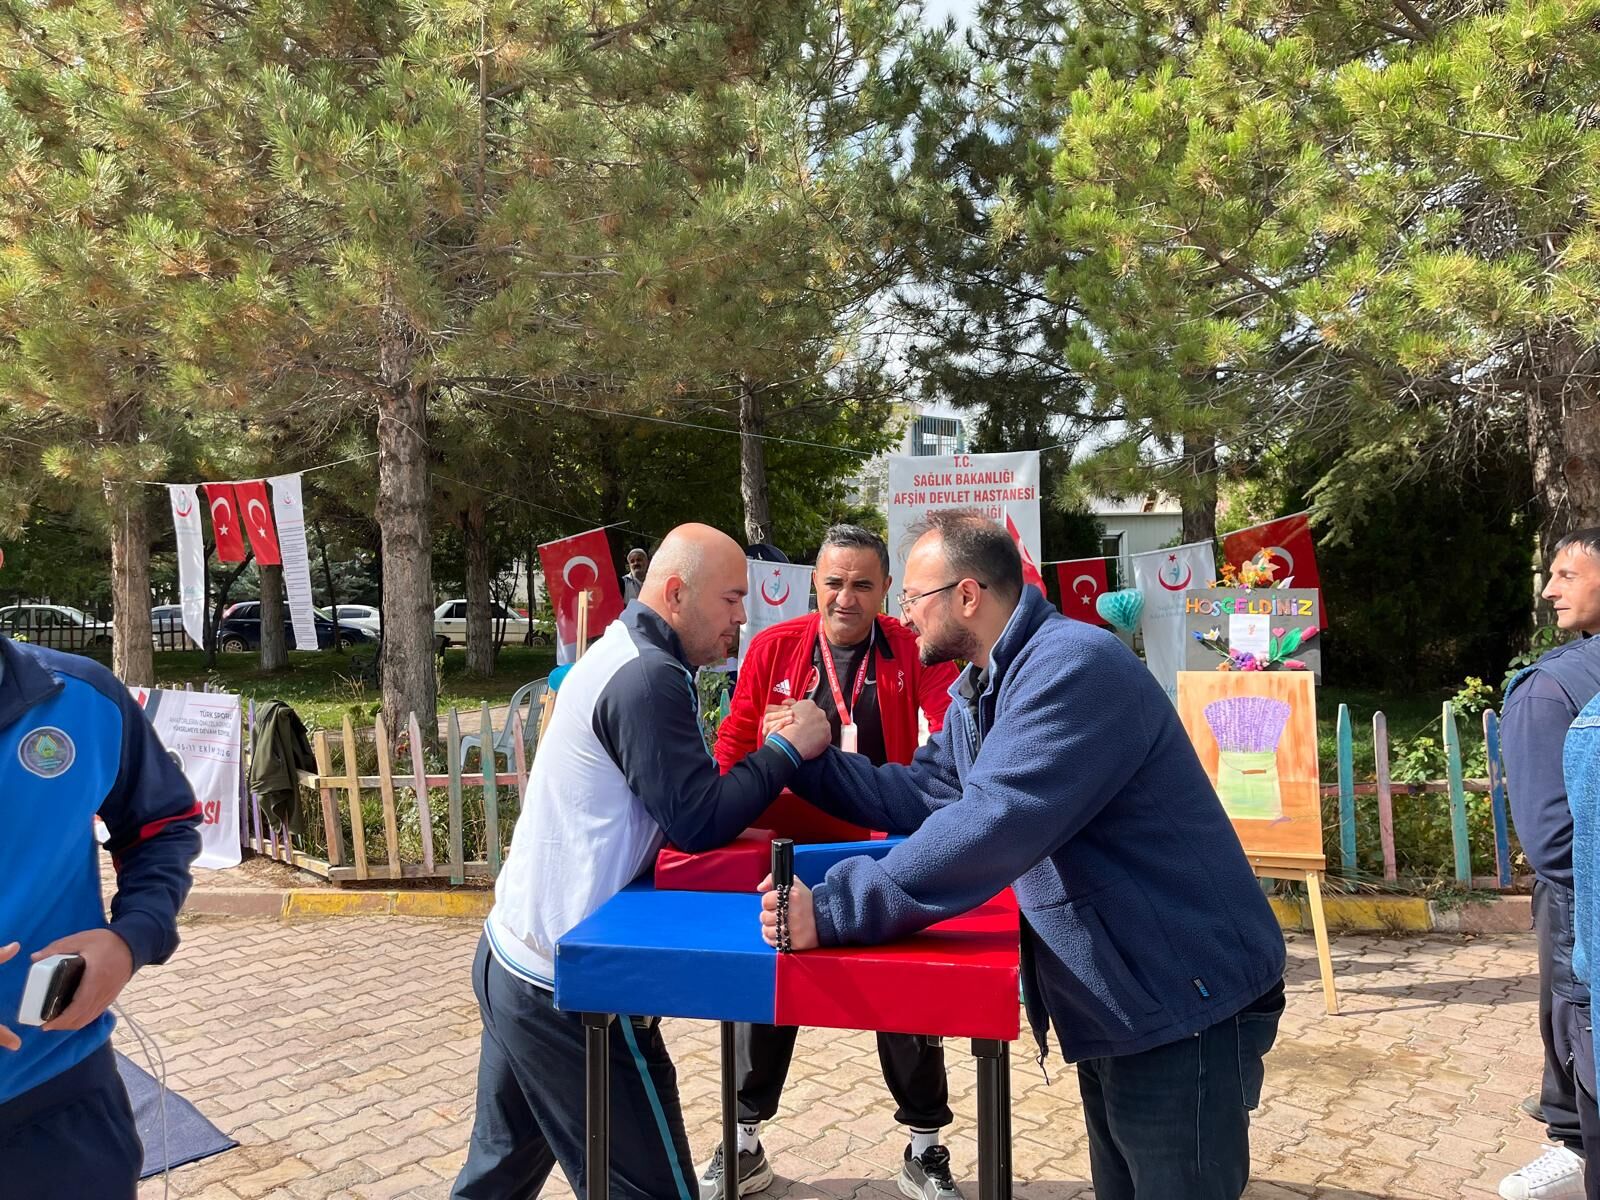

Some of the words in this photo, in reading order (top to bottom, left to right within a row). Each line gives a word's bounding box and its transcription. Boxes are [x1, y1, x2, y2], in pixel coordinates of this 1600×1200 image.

[953, 455, 974, 468] T.C.
[913, 472, 952, 487] SAĞLIK
[956, 468, 1014, 485] BAKANLIĞI
[894, 490, 926, 507] AFŞİN
[930, 490, 970, 504] DEVLET
[974, 485, 1035, 503] HASTANESİ
[200, 709, 214, 718] TÜRK
